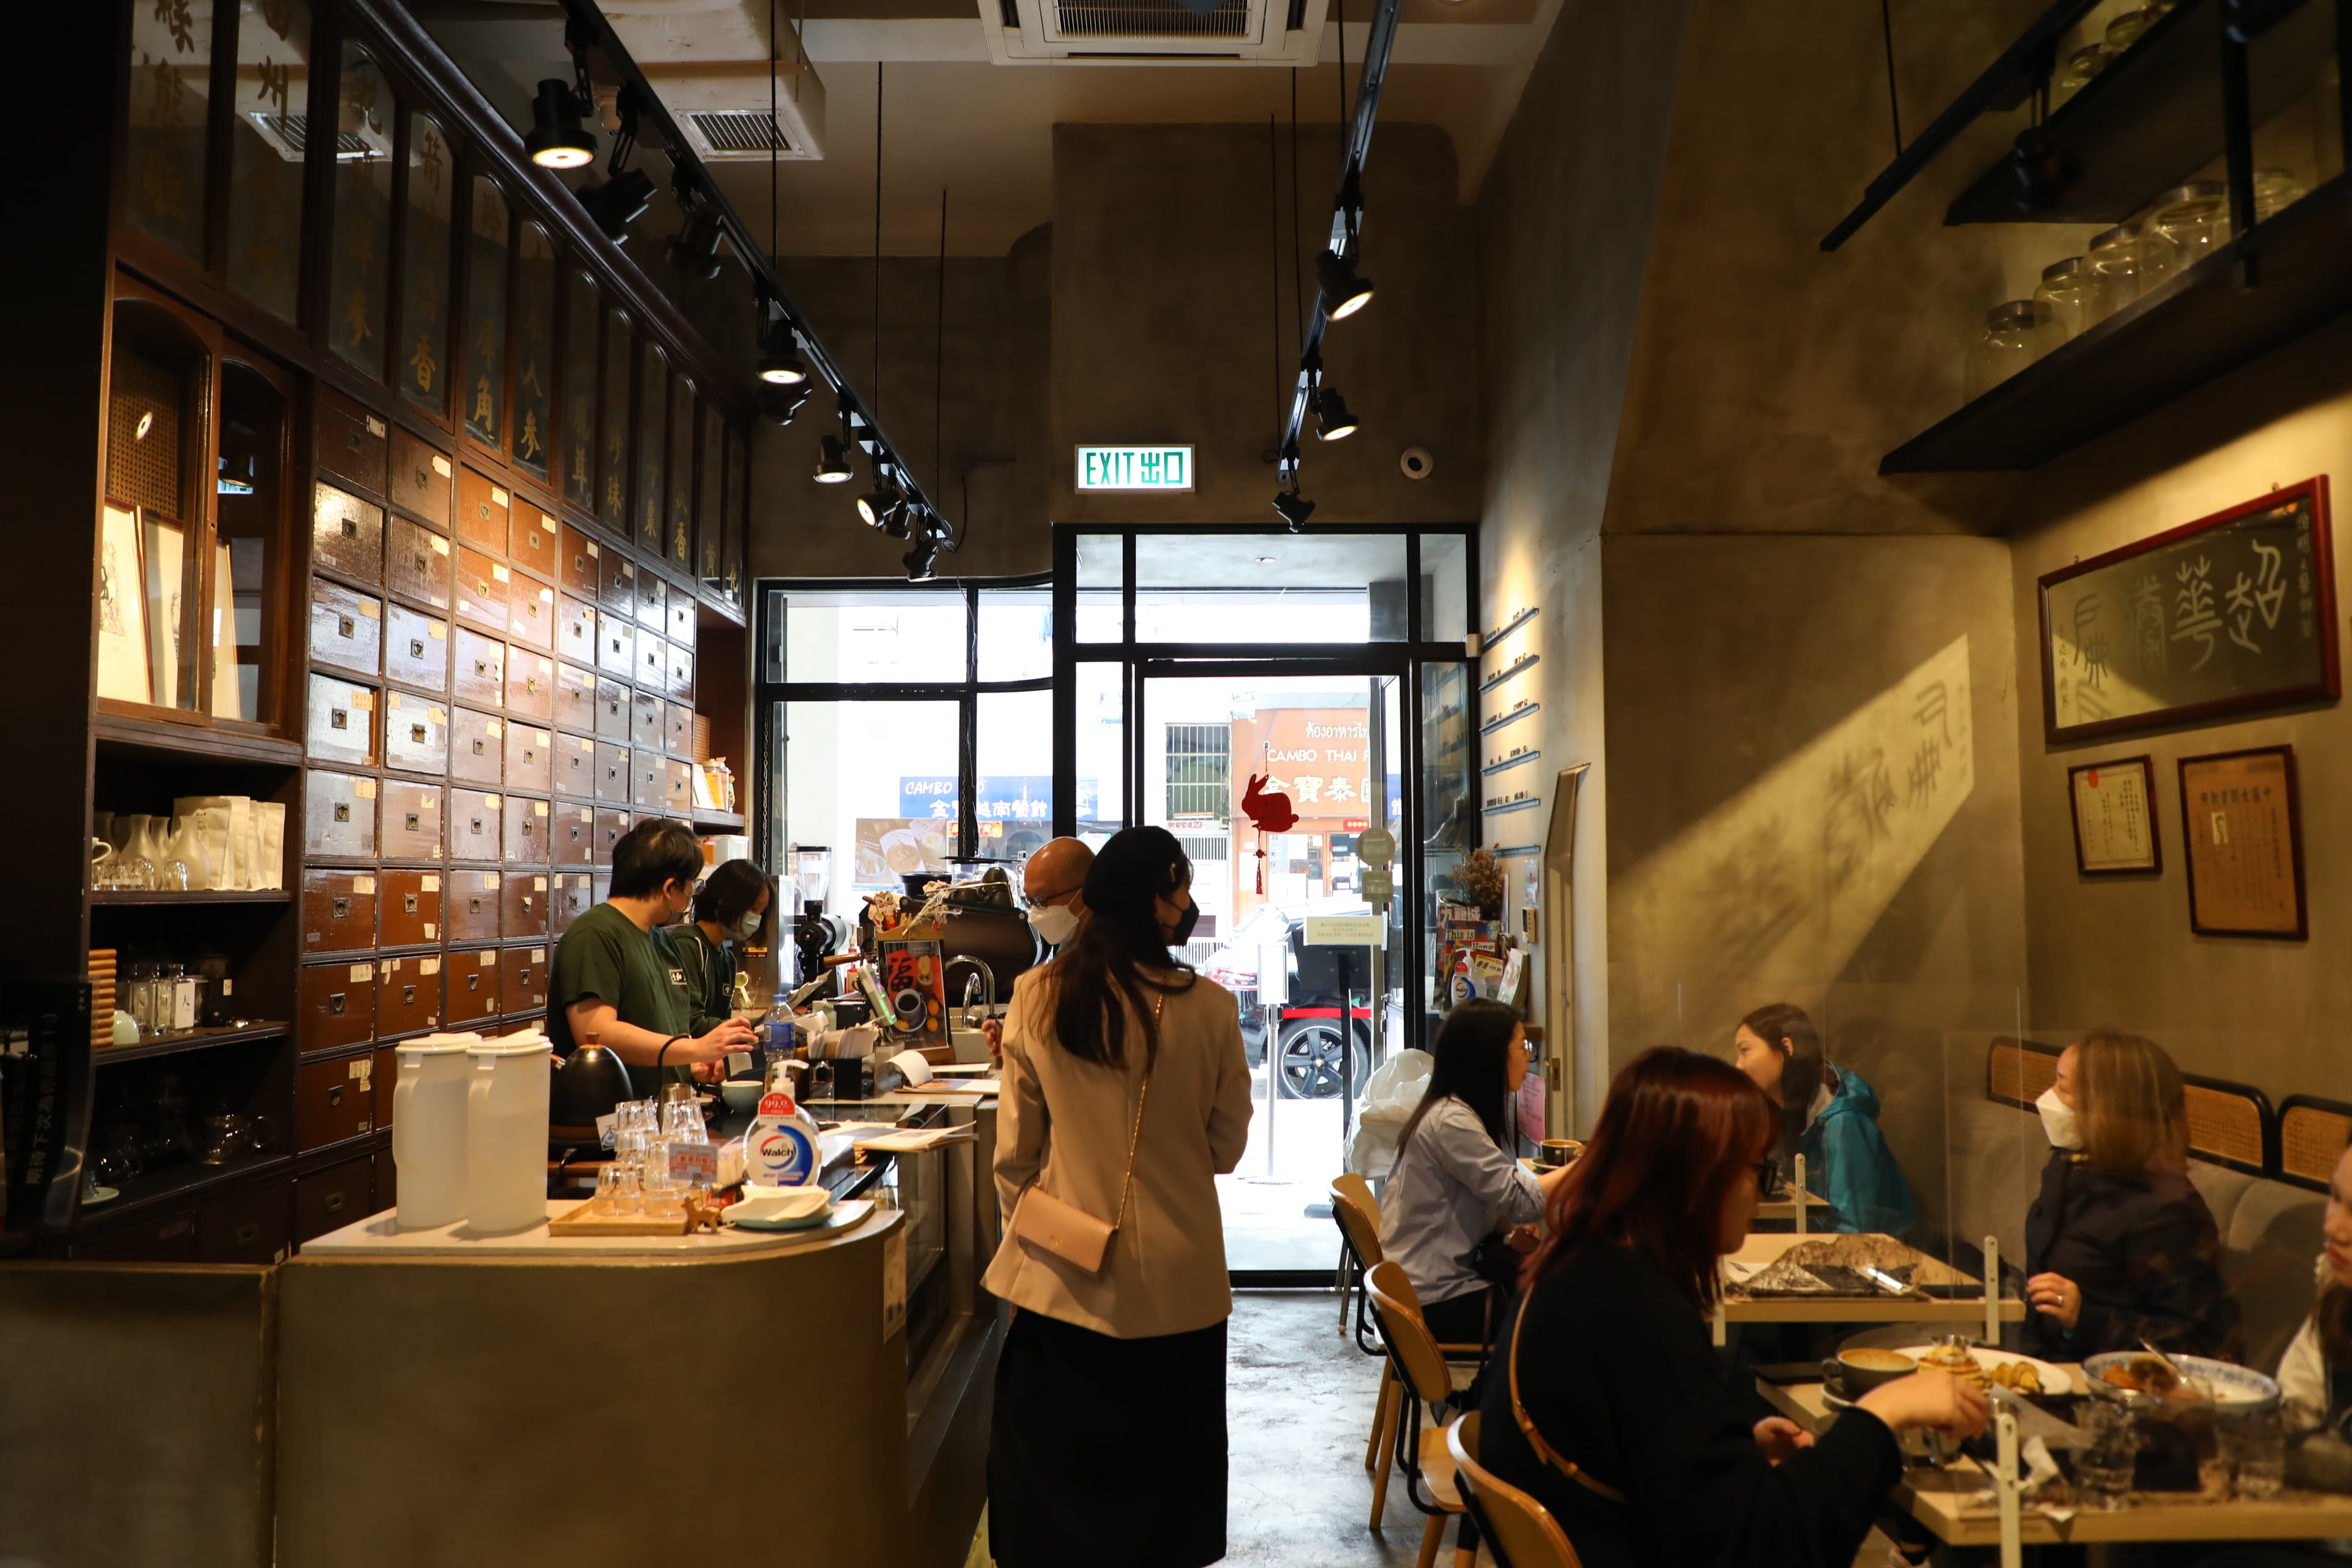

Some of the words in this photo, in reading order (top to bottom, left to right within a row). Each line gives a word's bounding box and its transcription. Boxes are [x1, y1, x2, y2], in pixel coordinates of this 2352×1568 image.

[1087, 452, 1134, 484] EXIT
[1140, 452, 1183, 484] 出口
[1267, 748, 1317, 762] CAMBO
[1324, 749, 1357, 762] THAI
[905, 781, 953, 796] CAMBO
[1447, 929, 1464, 940] This
[1467, 930, 1474, 940] is
[761, 1147, 794, 1157] Walch
